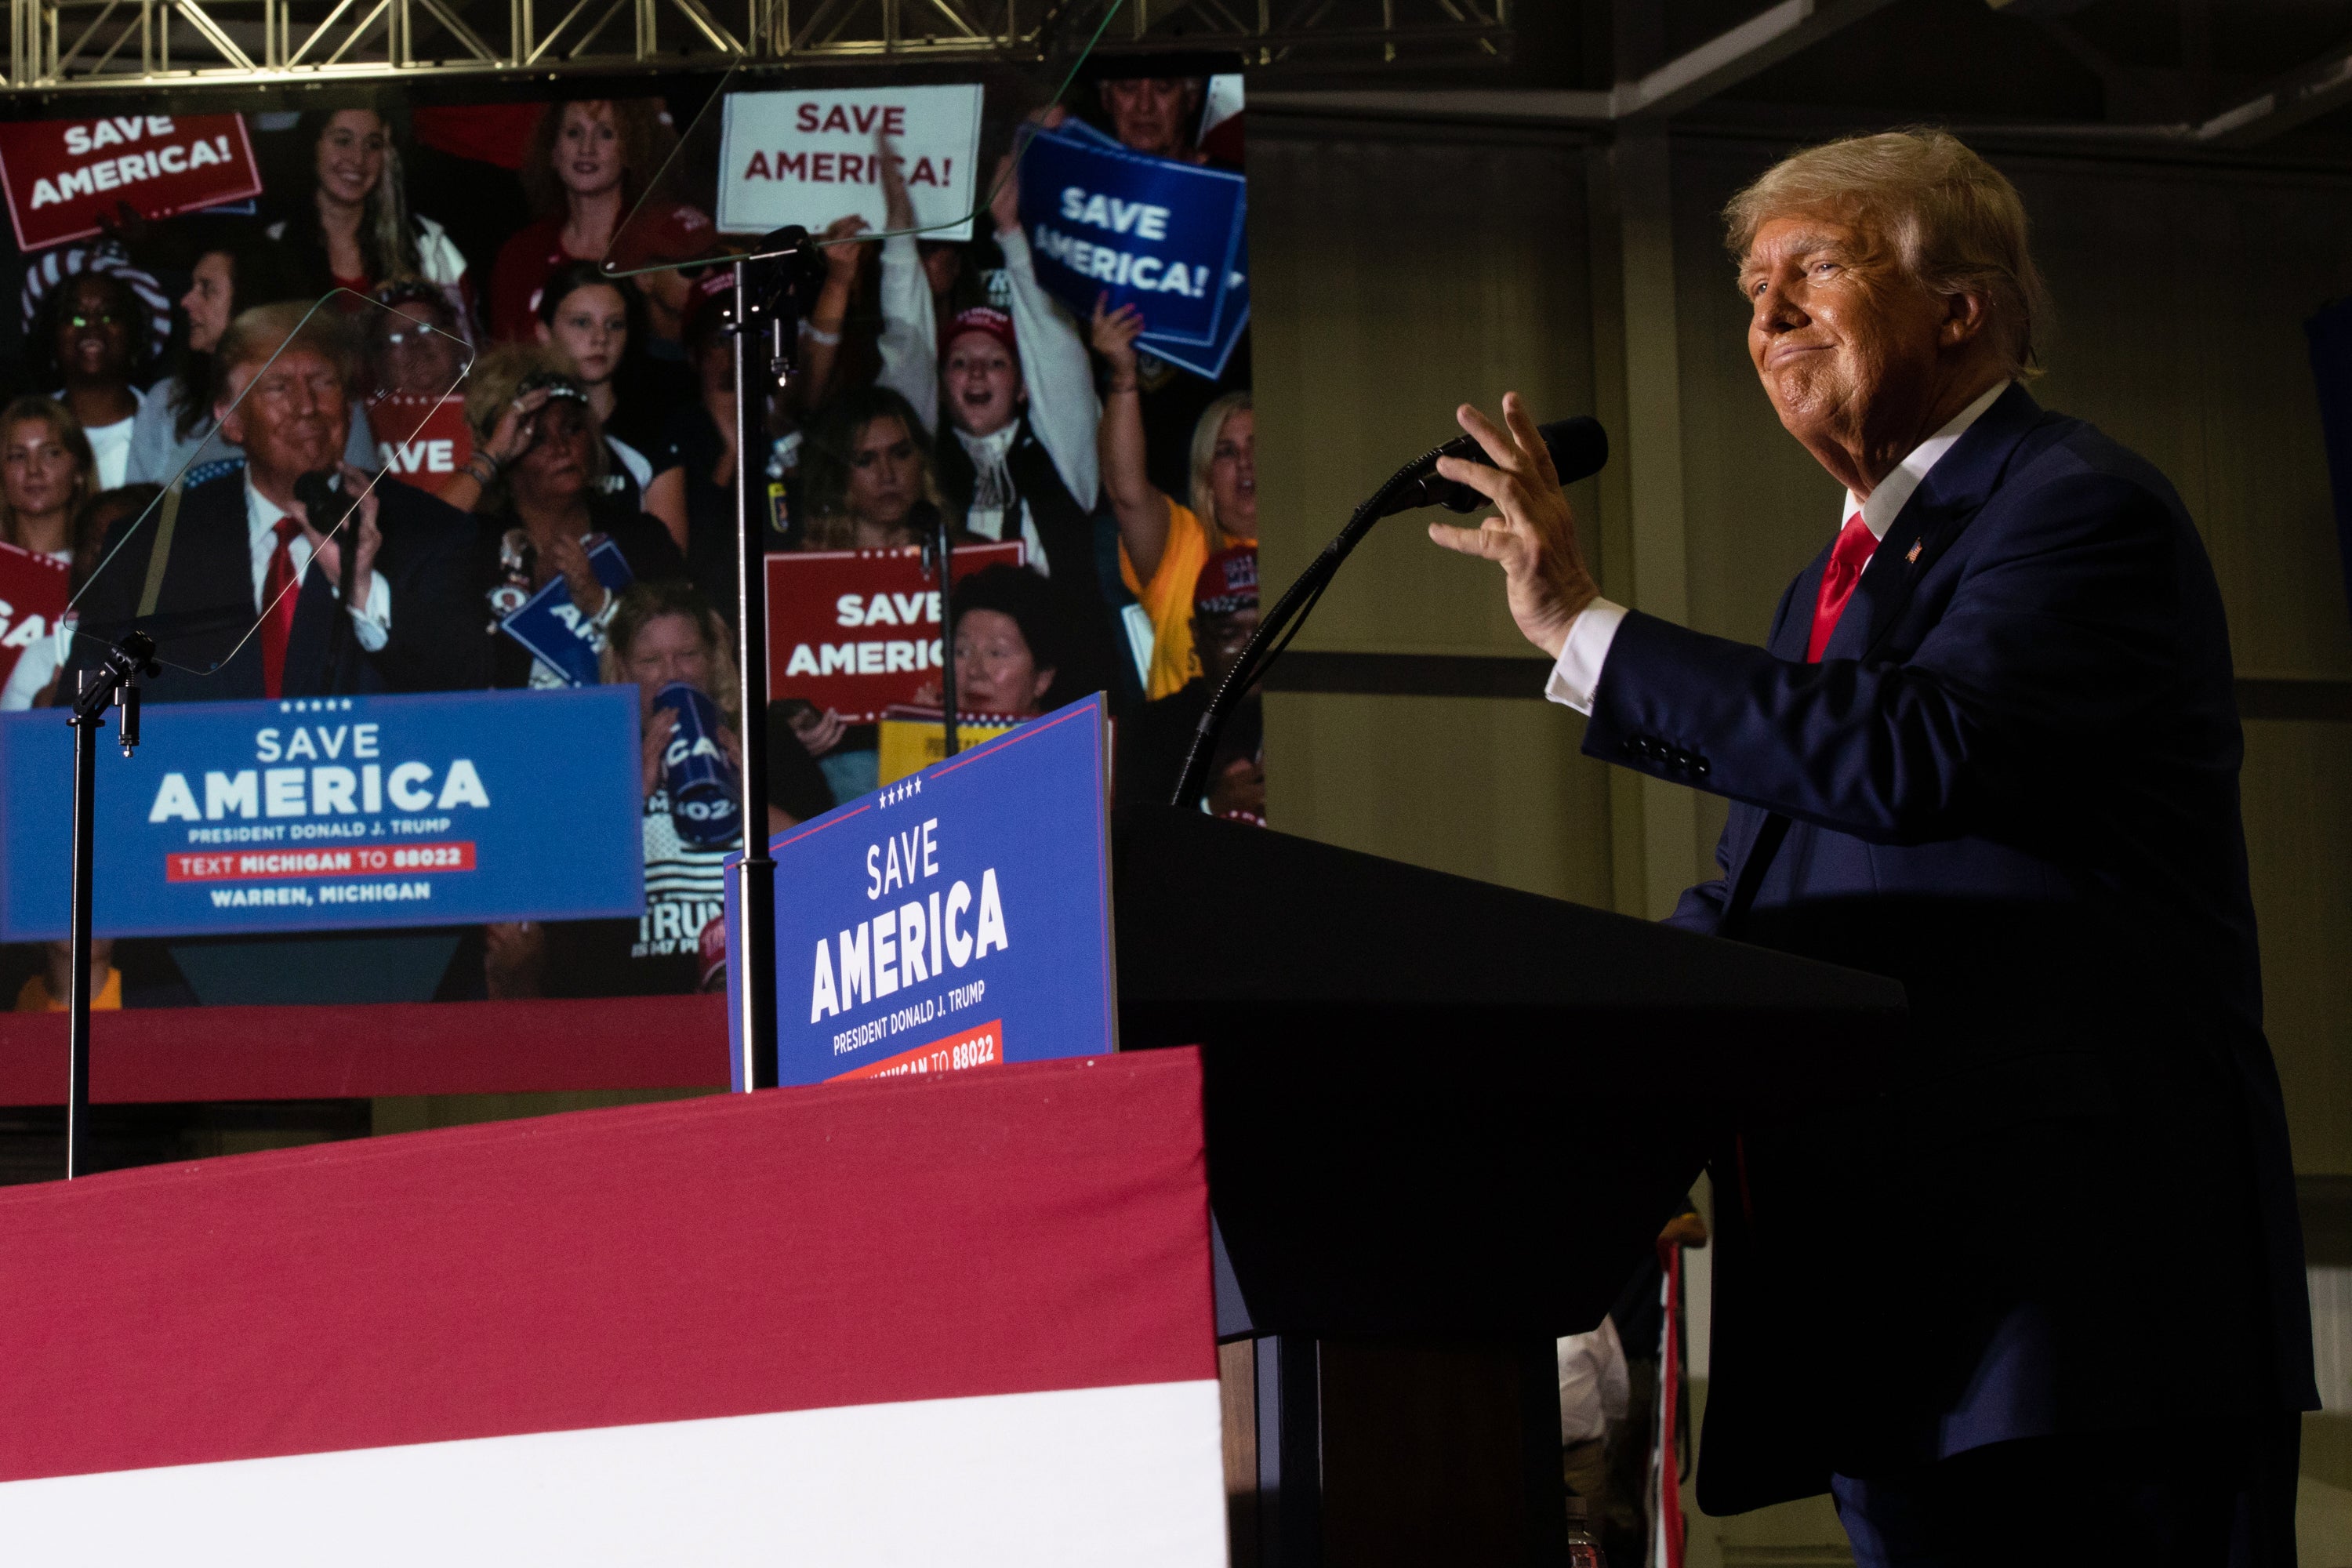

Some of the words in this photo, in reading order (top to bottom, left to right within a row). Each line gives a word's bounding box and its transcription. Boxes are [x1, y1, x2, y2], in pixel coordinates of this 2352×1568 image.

[64, 115, 175, 155] SAVE
[796, 103, 906, 136] SAVE
[30, 135, 233, 210] AMERICA!
[744, 150, 953, 187] AMERIA!
[1061, 187, 1171, 241] SAVE
[836, 590, 942, 626] SAVE
[256, 723, 379, 763] SAVE
[148, 759, 491, 822] AMERICA
[188, 825, 285, 844] PRESIDENT
[290, 822, 366, 840] DONALD
[370, 822, 385, 836] J.
[391, 818, 452, 835] TRUMP
[180, 856, 234, 876] TEXT
[240, 851, 352, 873] MICHIGAN
[358, 851, 388, 869] TO
[394, 848, 461, 868] 88022
[866, 818, 939, 900] SAVE
[210, 887, 314, 908] WARREN,
[319, 882, 431, 904] MICHIGAN
[811, 868, 1008, 1024] AMERICA
[833, 1017, 887, 1056] PRESIDENT
[891, 1000, 935, 1035] DONALD
[937, 995, 946, 1017] J.
[948, 980, 985, 1013] TRUMP
[931, 1051, 949, 1072] TO
[953, 1034, 994, 1071] 88022
